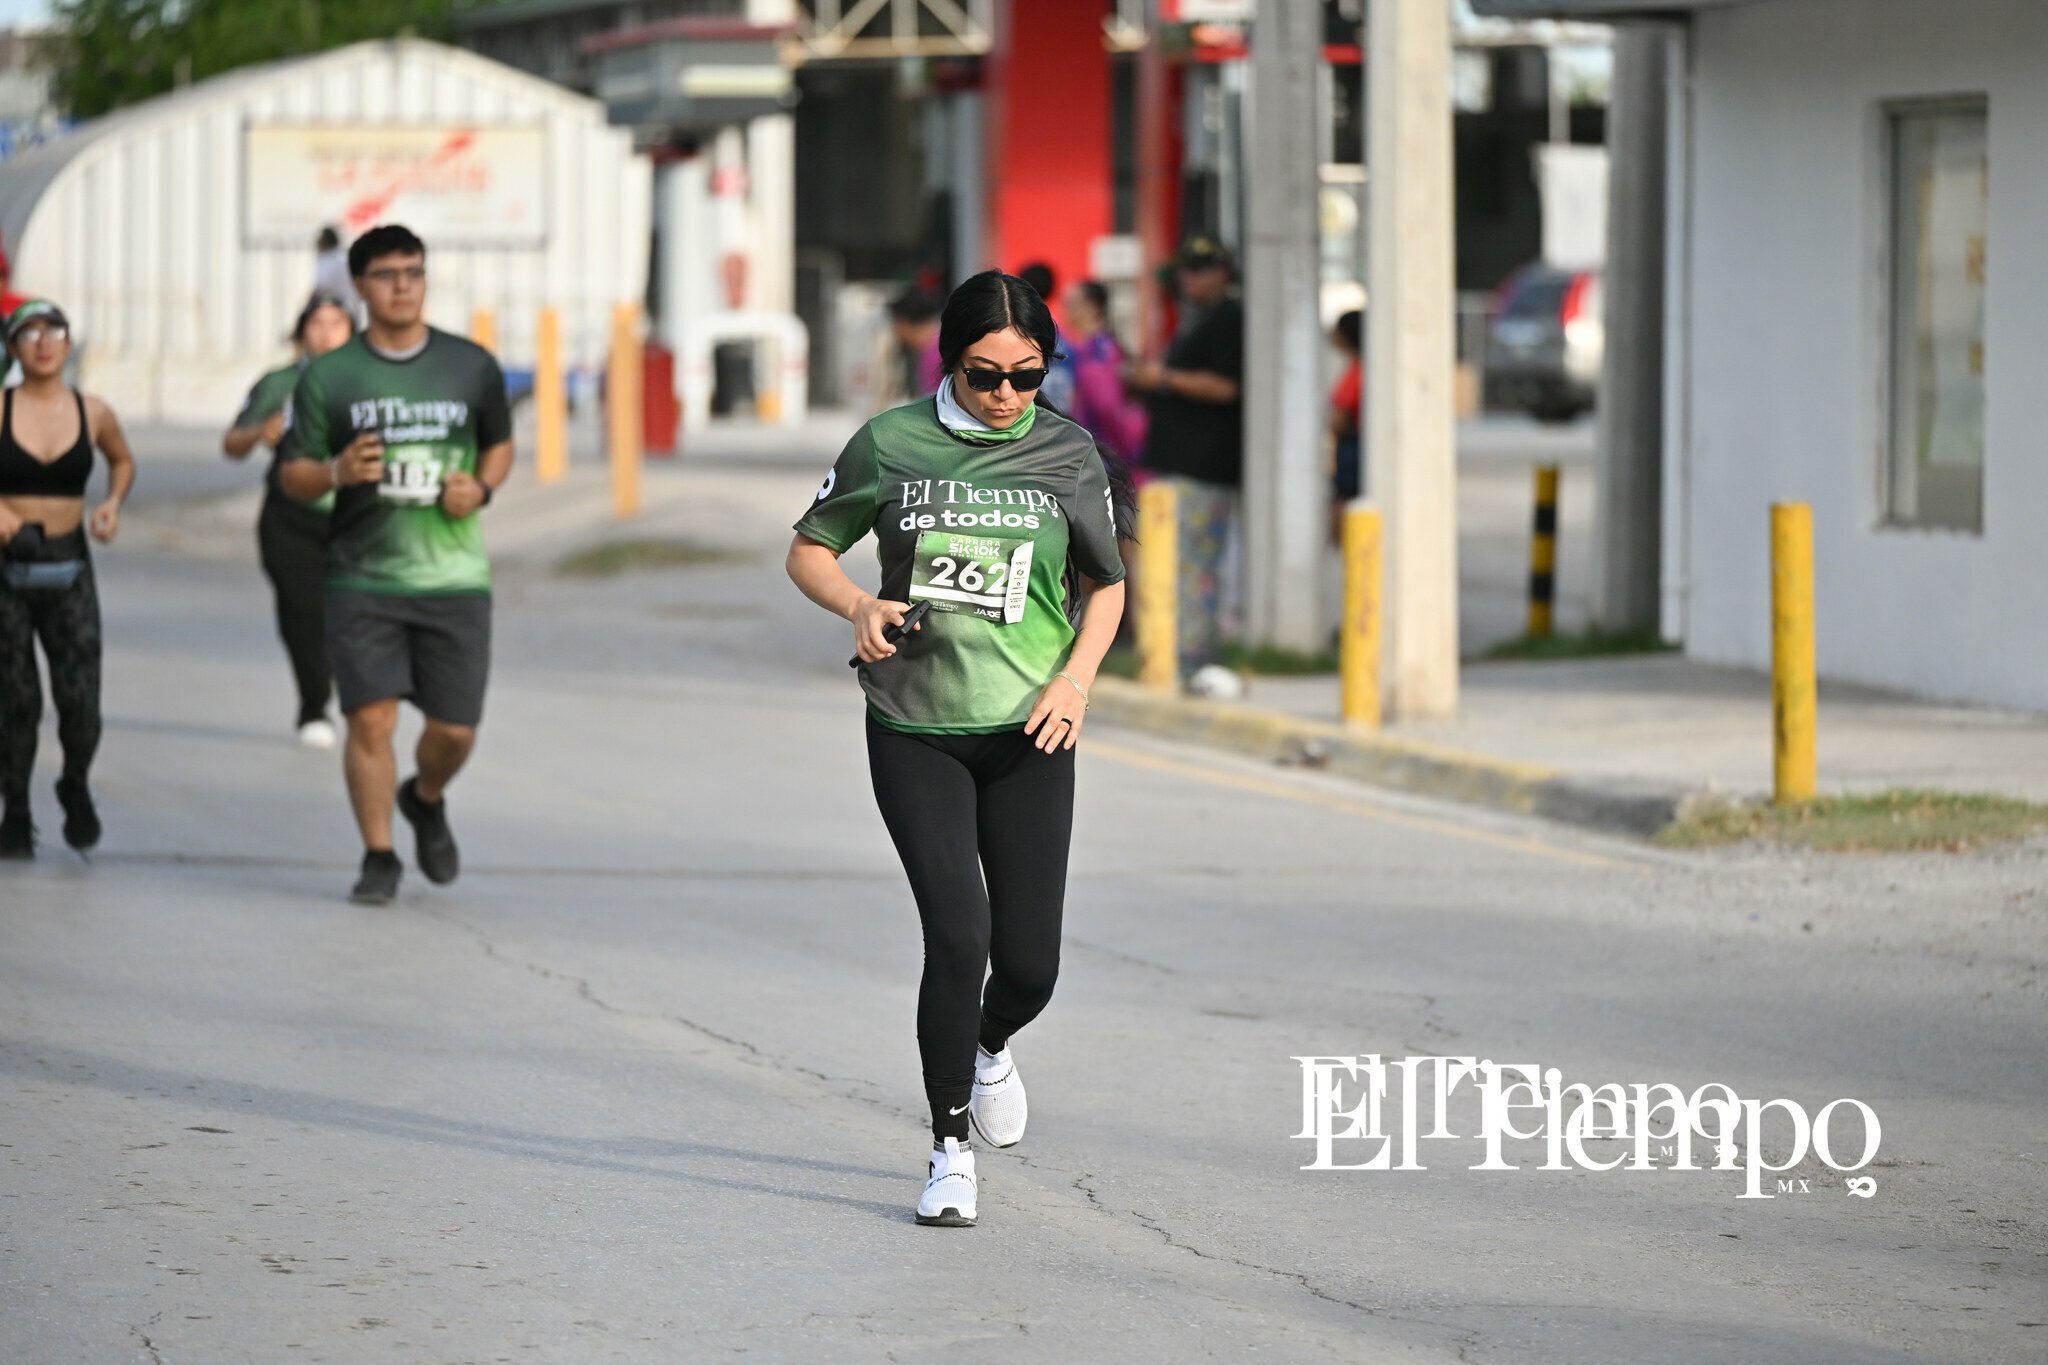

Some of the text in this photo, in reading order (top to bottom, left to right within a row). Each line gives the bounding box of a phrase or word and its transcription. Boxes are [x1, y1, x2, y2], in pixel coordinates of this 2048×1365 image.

[900, 479, 1058, 513] El Tiempo
[900, 510, 1040, 531] de todos
[950, 536, 1000, 547] CARRERA
[928, 556, 1011, 594] 262
